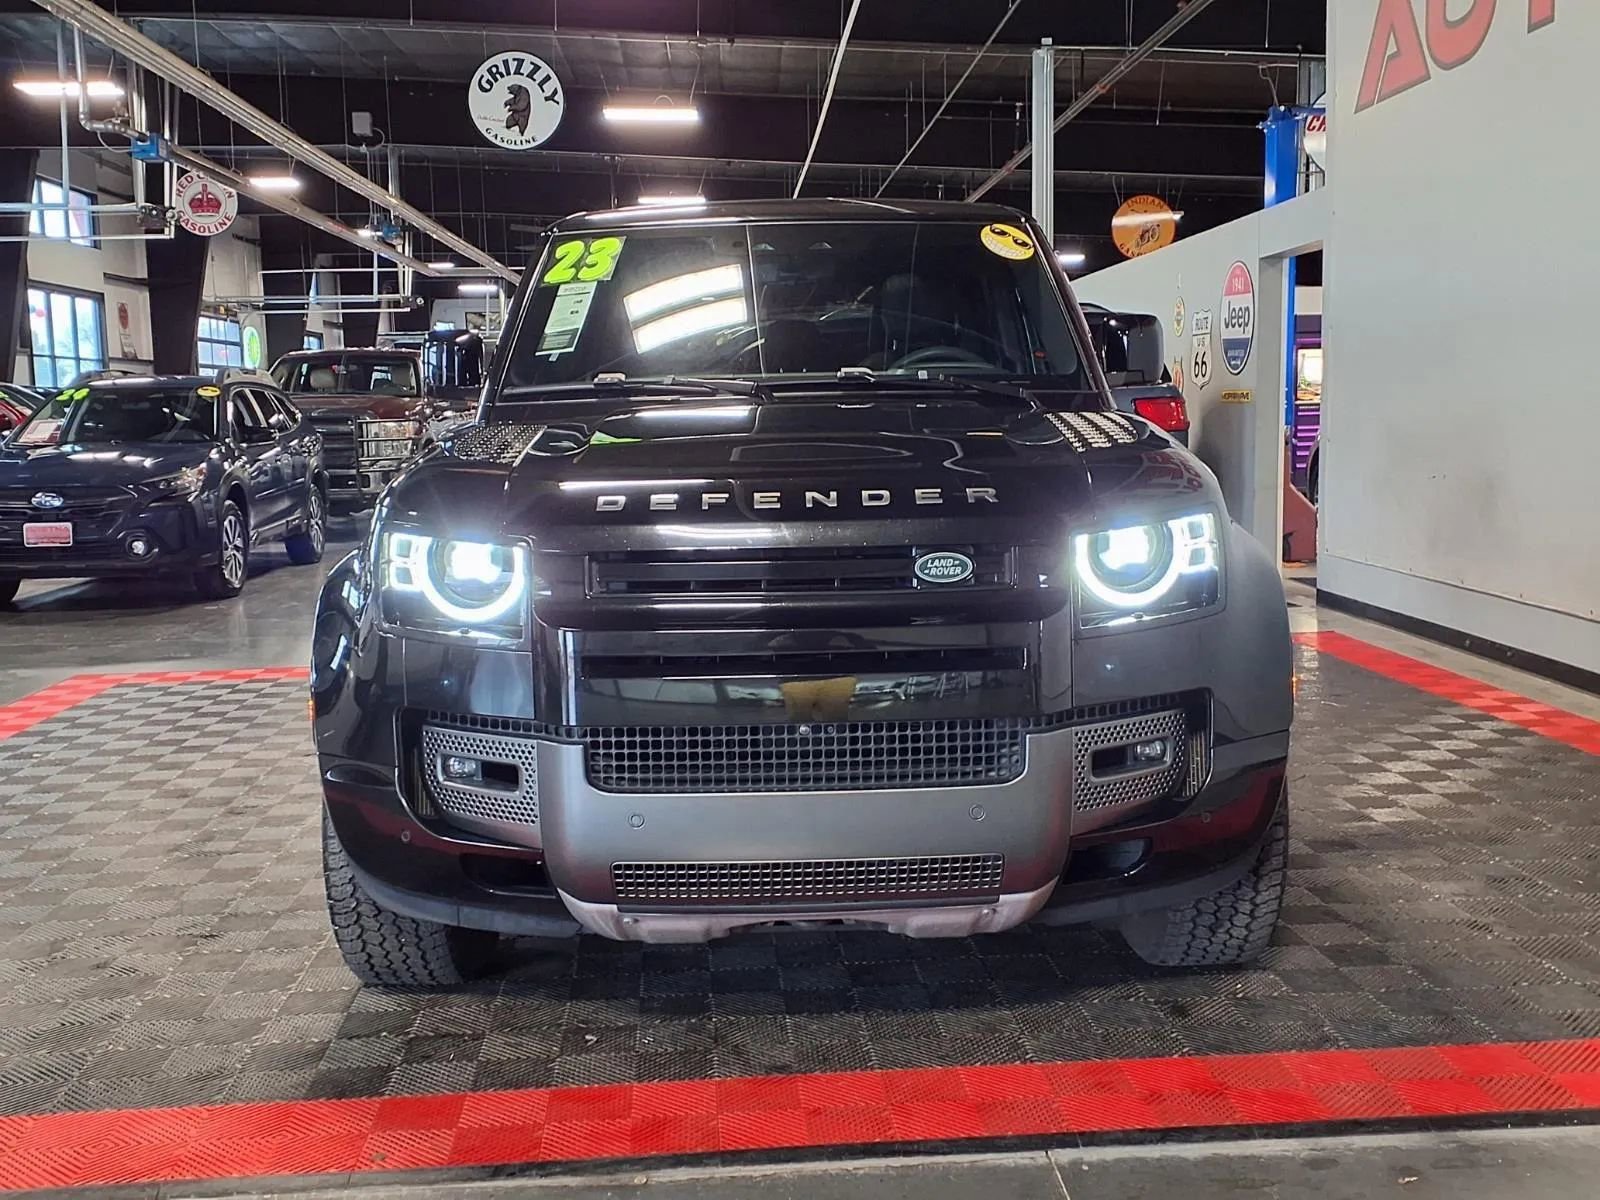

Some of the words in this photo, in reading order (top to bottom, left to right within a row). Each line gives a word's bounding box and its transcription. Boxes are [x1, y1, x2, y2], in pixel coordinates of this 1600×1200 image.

[477, 58, 560, 105] GRIZZLY
[485, 127, 537, 146] GASOLINE
[176, 174, 194, 198] RED
[1126, 196, 1165, 209] INDIAN
[177, 210, 233, 234] GASOLINE
[544, 237, 620, 284] 23
[1195, 316, 1209, 330] ROUTE
[1224, 301, 1250, 334] Jeep
[1194, 351, 1207, 378] 66
[596, 487, 999, 512] DEFENDER
[927, 558, 954, 568] LAND
[929, 566, 962, 576] ROVER
